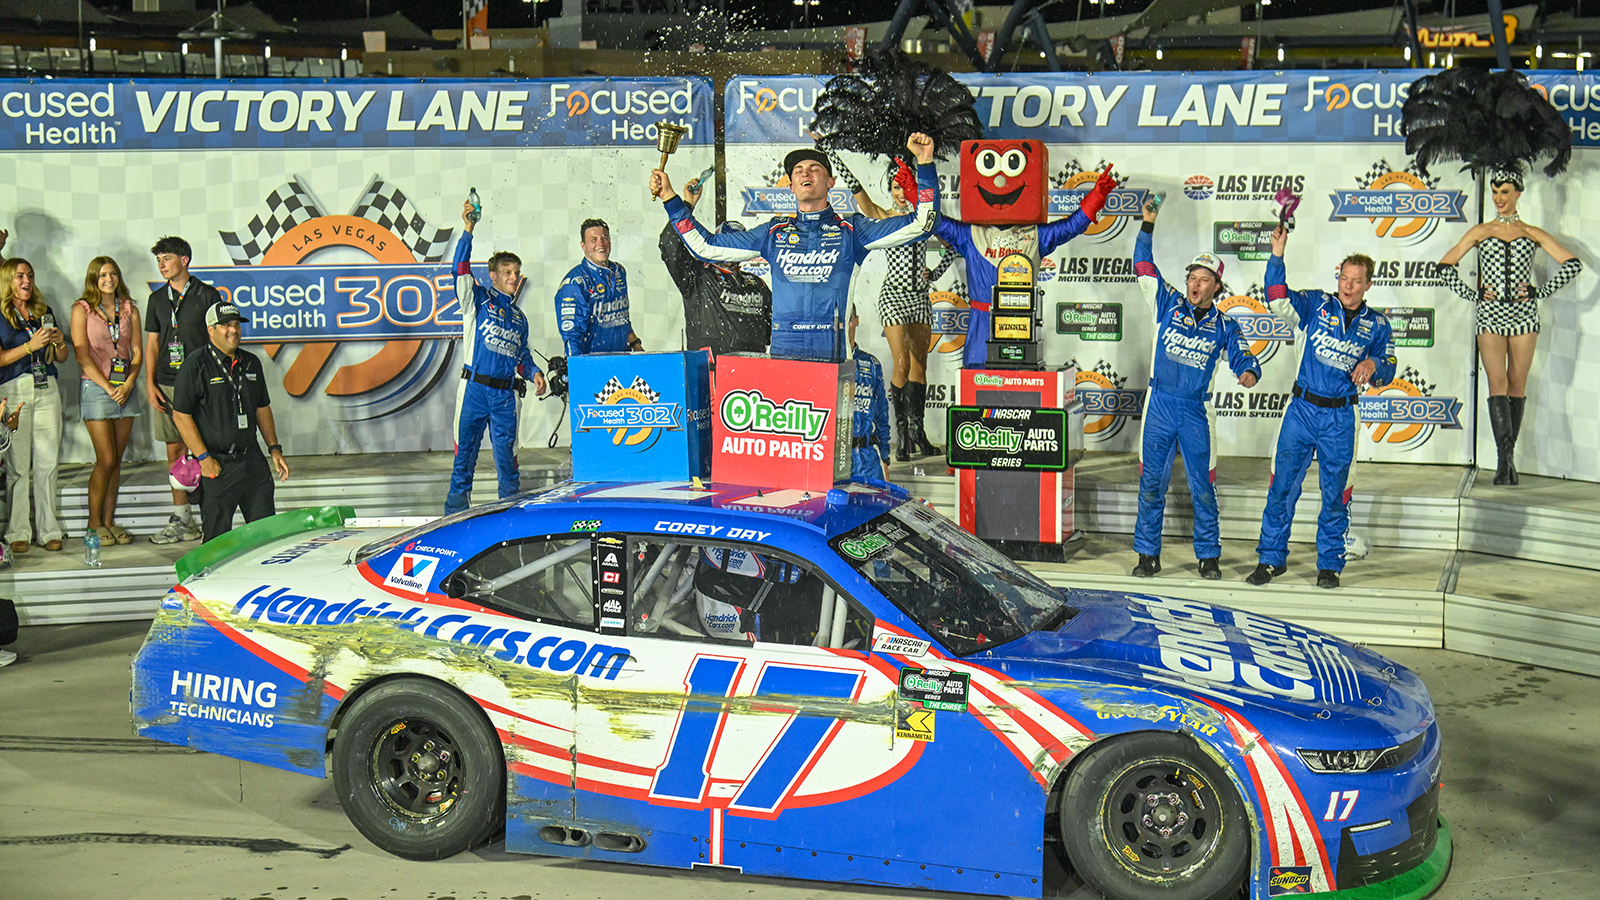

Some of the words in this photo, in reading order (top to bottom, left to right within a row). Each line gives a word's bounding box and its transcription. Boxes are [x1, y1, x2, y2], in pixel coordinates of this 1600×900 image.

[2, 82, 115, 118] cused
[550, 81, 692, 117] Focused
[737, 81, 822, 114] Focu
[971, 84, 1129, 127] TORY
[1137, 83, 1288, 127] LANE
[135, 90, 376, 133] VICTORY
[386, 90, 529, 131] LANE
[25, 121, 116, 145] Health
[611, 119, 693, 140] Heah
[1217, 175, 1248, 193] LAS
[1252, 175, 1305, 193] VEGAS
[1105, 192, 1139, 212] 02
[1344, 193, 1393, 206] Focused
[1365, 204, 1393, 213] Health
[1396, 194, 1451, 214] 302
[292, 229, 323, 252] LAS
[332, 225, 387, 251] VEGAS
[1221, 230, 1256, 243] O'Reilly
[776, 249, 840, 268] Hendrick
[1059, 257, 1089, 274] LAS
[1092, 257, 1135, 275] VEGA
[783, 263, 833, 276] Cars.com
[1404, 261, 1437, 279] VEG
[208, 277, 325, 308] cused
[252, 309, 326, 329] Health
[941, 311, 970, 330] 30
[998, 323, 1028, 331] WINNER
[1063, 310, 1097, 326] O'Reilly
[1238, 317, 1291, 336] 302
[1409, 323, 1430, 331] PARTS
[1161, 327, 1217, 354] Hendrick
[1165, 342, 1210, 364] Cars.com
[974, 373, 1003, 386] O'Reilly
[1004, 377, 1022, 385] AUTO
[1023, 378, 1045, 386] PARTS
[926, 385, 946, 401] AS
[1086, 392, 1137, 412] 302
[1215, 392, 1244, 409] LAS
[1249, 393, 1291, 410] VEGA
[587, 408, 624, 419] Focused
[627, 406, 671, 424] 302
[726, 393, 823, 436] O'Reilly
[994, 409, 1032, 420] NASCAR
[1391, 399, 1447, 419] 302
[603, 416, 626, 425] Health
[960, 425, 1020, 450] O'Reilly
[1027, 428, 1056, 440] AUTO
[721, 437, 767, 458] AUTO
[770, 439, 824, 462] PARTS
[1024, 440, 1058, 452] PARTS
[991, 458, 1022, 468] SERIES
[653, 520, 724, 536] COREY
[726, 528, 771, 542] DAY
[415, 545, 435, 554] CHECK
[435, 547, 458, 558] POINT
[390, 575, 423, 591] Valvoline
[604, 572, 619, 583] CI
[705, 612, 738, 624] Hendrick
[881, 644, 901, 652] RACE
[903, 646, 919, 654] CAR
[892, 637, 923, 648] NASCAR
[171, 670, 277, 708] HIRING
[906, 675, 941, 692] O'Reilly
[943, 687, 964, 695] PARTS
[946, 680, 963, 688] AUTO
[170, 701, 275, 728] TECHNICIANS
[928, 701, 940, 709] THE
[941, 702, 963, 711] CHASE
[649, 654, 867, 821] 17
[896, 731, 933, 740] KENNAMETAL
[1323, 790, 1360, 822] 17
[1270, 875, 1309, 885] SUNOCO
